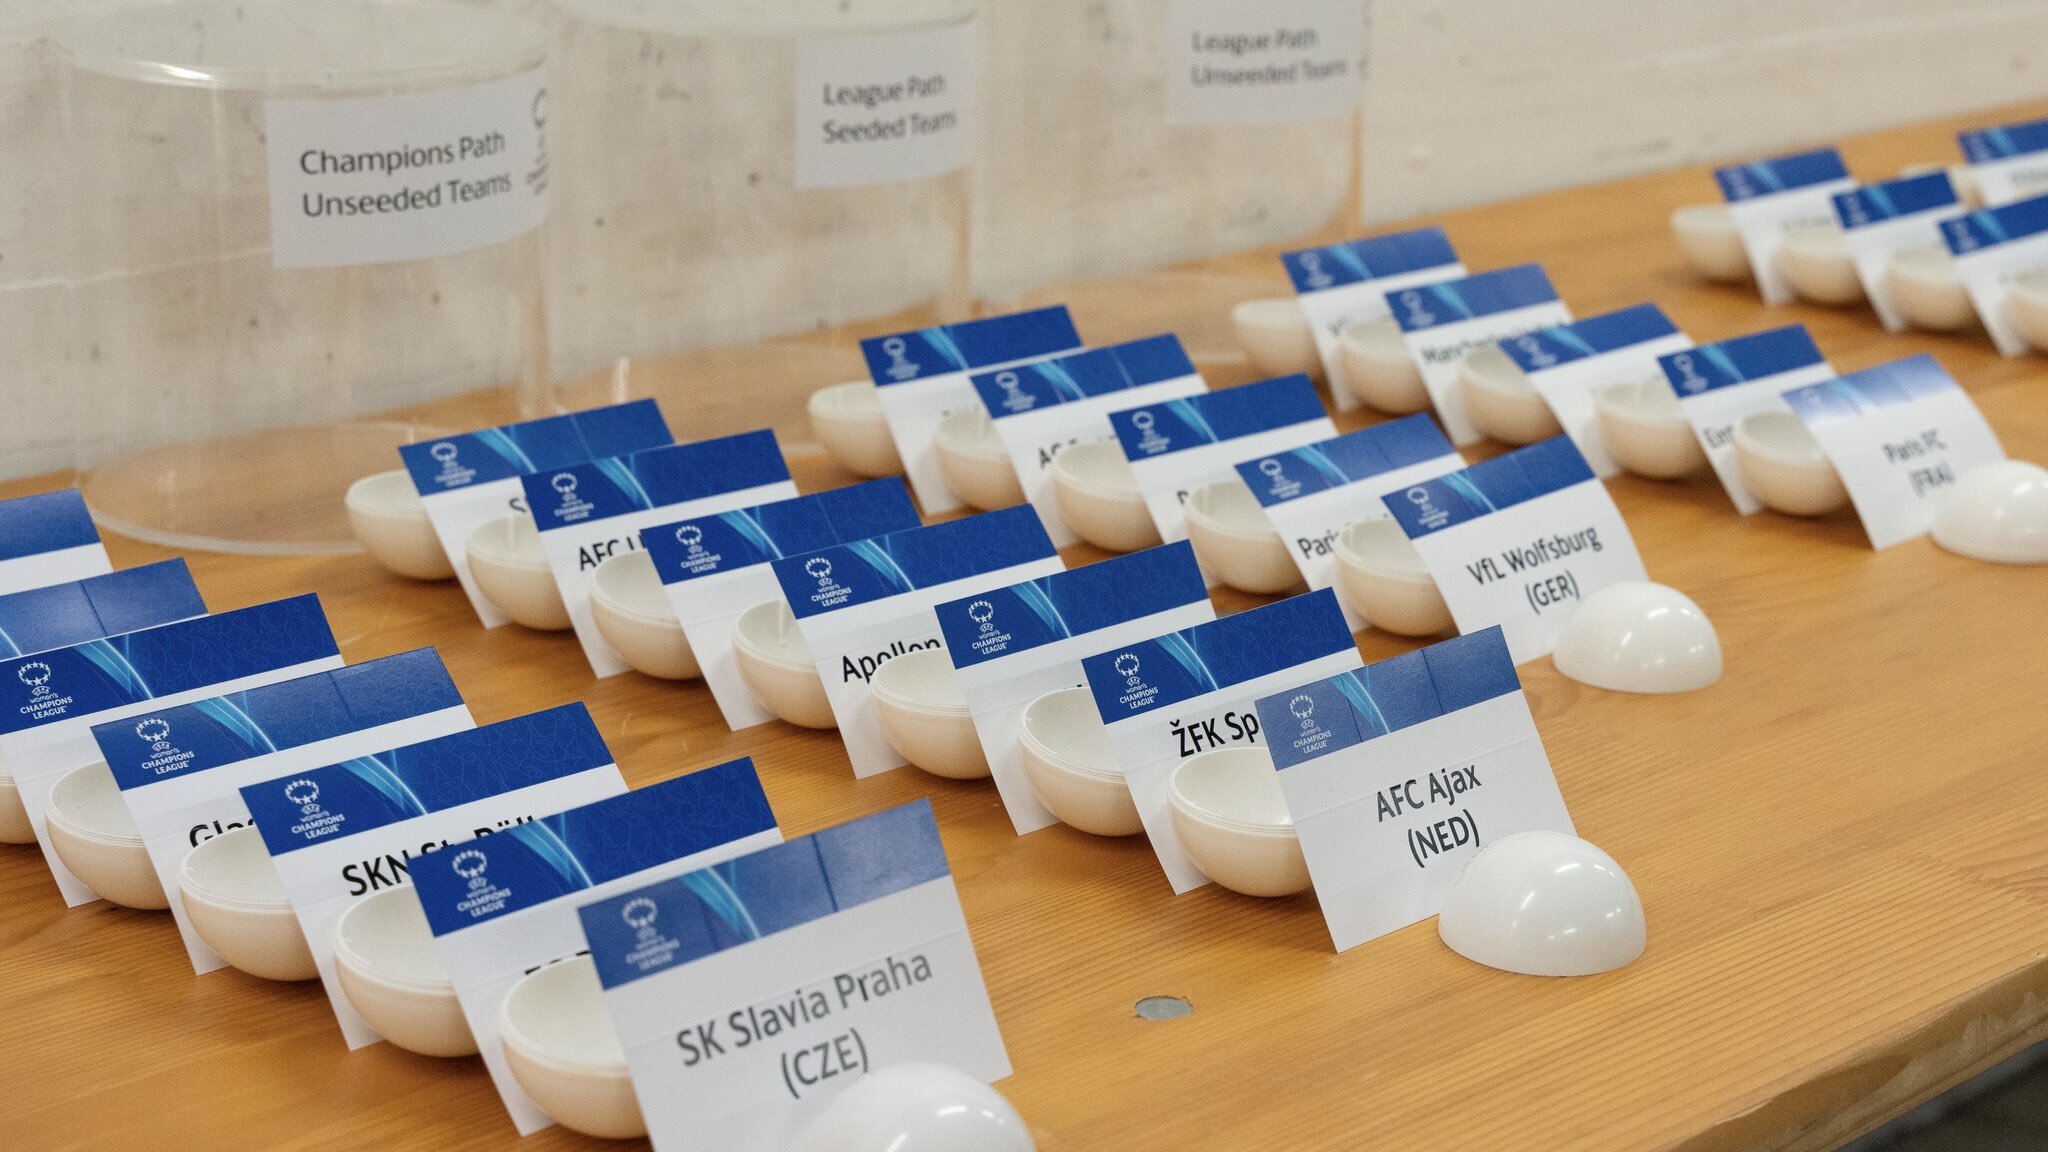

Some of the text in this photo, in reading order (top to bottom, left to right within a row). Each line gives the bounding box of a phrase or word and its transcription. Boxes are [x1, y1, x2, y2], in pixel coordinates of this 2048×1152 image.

[822, 73, 947, 109] League Path
[822, 119, 906, 144] Seeded
[300, 130, 506, 176] Champions Path
[302, 184, 442, 218] Unseeded
[447, 172, 513, 204] Teams
[1466, 527, 1602, 585] VfL Wolfsburg
[811, 586, 852, 602] CHAMPIONS
[821, 594, 848, 607] LEAGUE
[1525, 570, 1580, 615] (GER)
[971, 633, 1012, 650] CHAMPIONS
[981, 642, 1007, 655] LEAGUE
[20, 696, 73, 715] CHAMPIONS
[1119, 687, 1159, 704] CHAMPIONS
[1129, 697, 1155, 709] LEAGUE
[32, 705, 67, 720] LEAGUE
[1169, 717, 1226, 758] ŽFK
[1293, 730, 1332, 749] CHAMPIONS
[1303, 740, 1328, 754] LEAGUE
[142, 751, 195, 770] CHAMPIONS
[154, 761, 189, 775] LEAGUE
[1376, 764, 1482, 823] AFC Ajax
[291, 813, 345, 834] CHAMPIONS
[305, 824, 340, 840] LEAGUE
[1407, 808, 1480, 869] (NED)
[342, 849, 411, 896] SKN
[676, 954, 933, 1067] SK Slavia Praha
[781, 1027, 869, 1100] (CZE)
